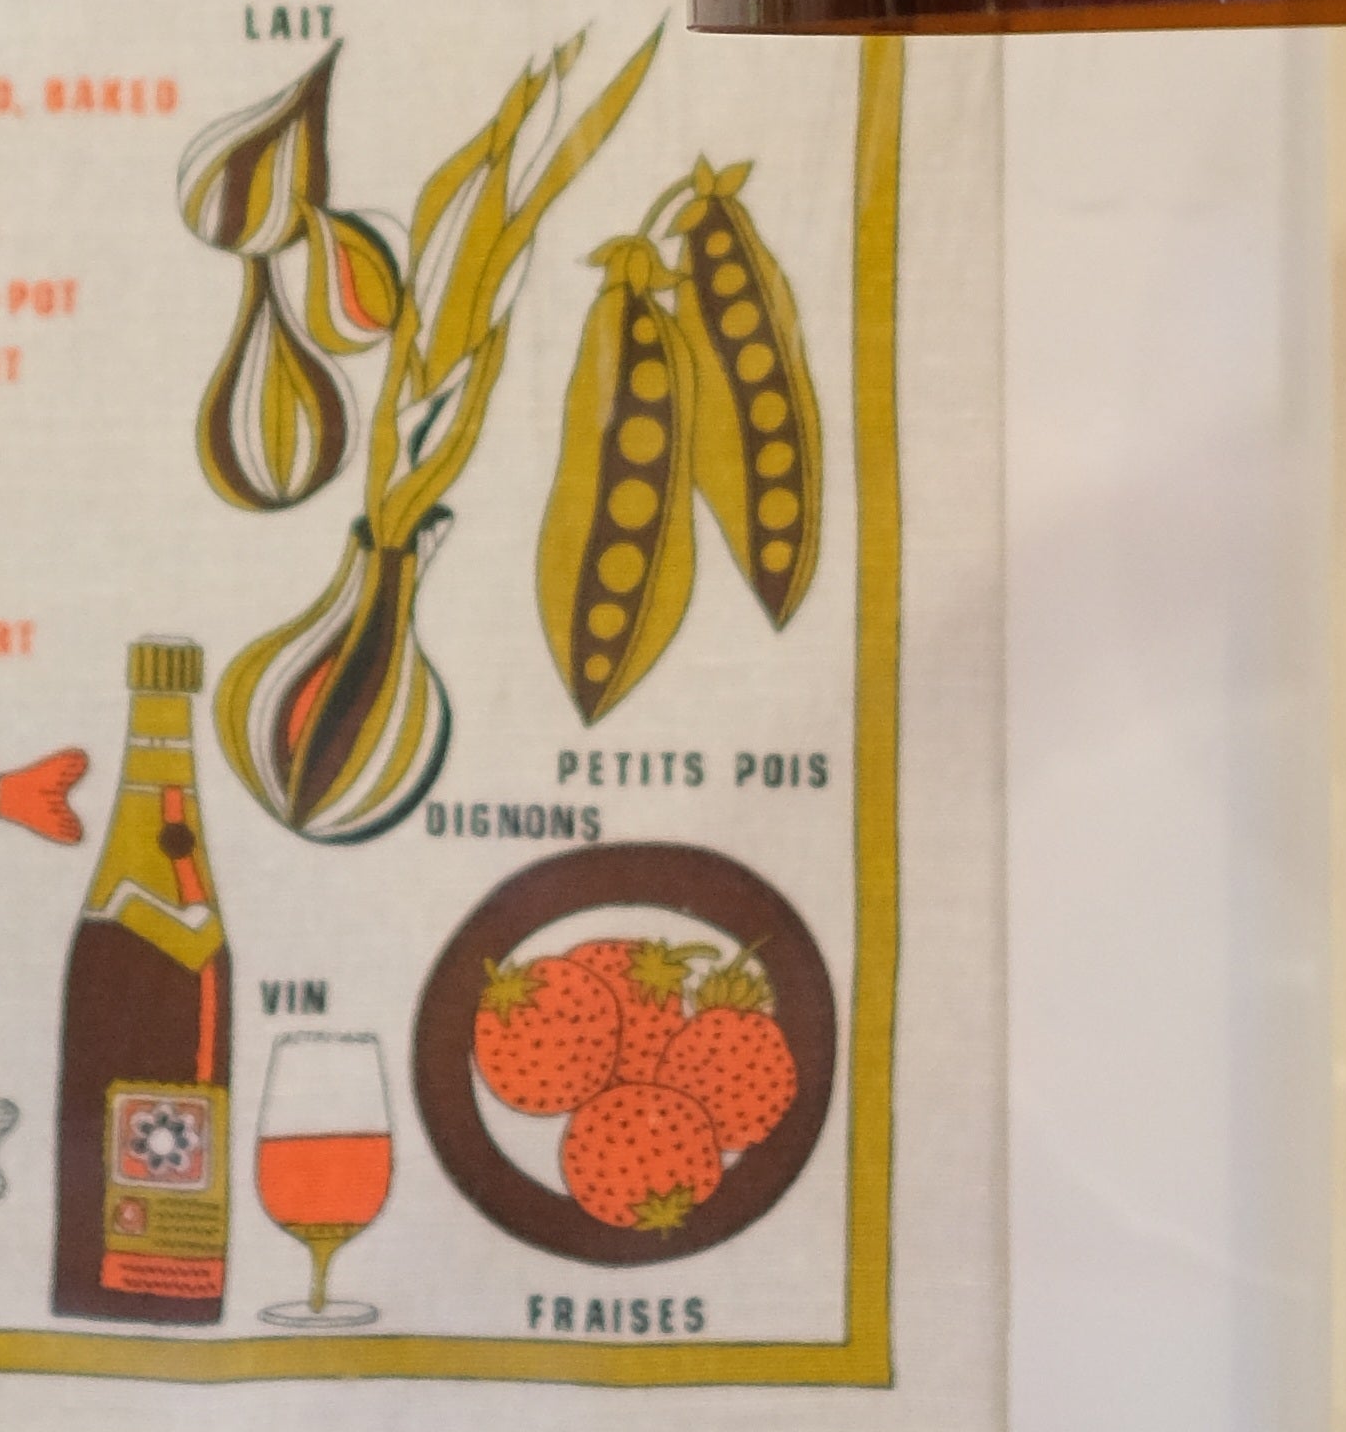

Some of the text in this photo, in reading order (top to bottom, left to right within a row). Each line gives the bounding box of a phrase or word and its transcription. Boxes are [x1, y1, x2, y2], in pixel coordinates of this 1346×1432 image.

[245, 6, 333, 40] LAIT
[558, 750, 828, 789] PETITS POIS
[425, 794, 598, 838] OIGNONS
[260, 980, 328, 1015] VIN
[528, 1295, 705, 1334] FRAISES
